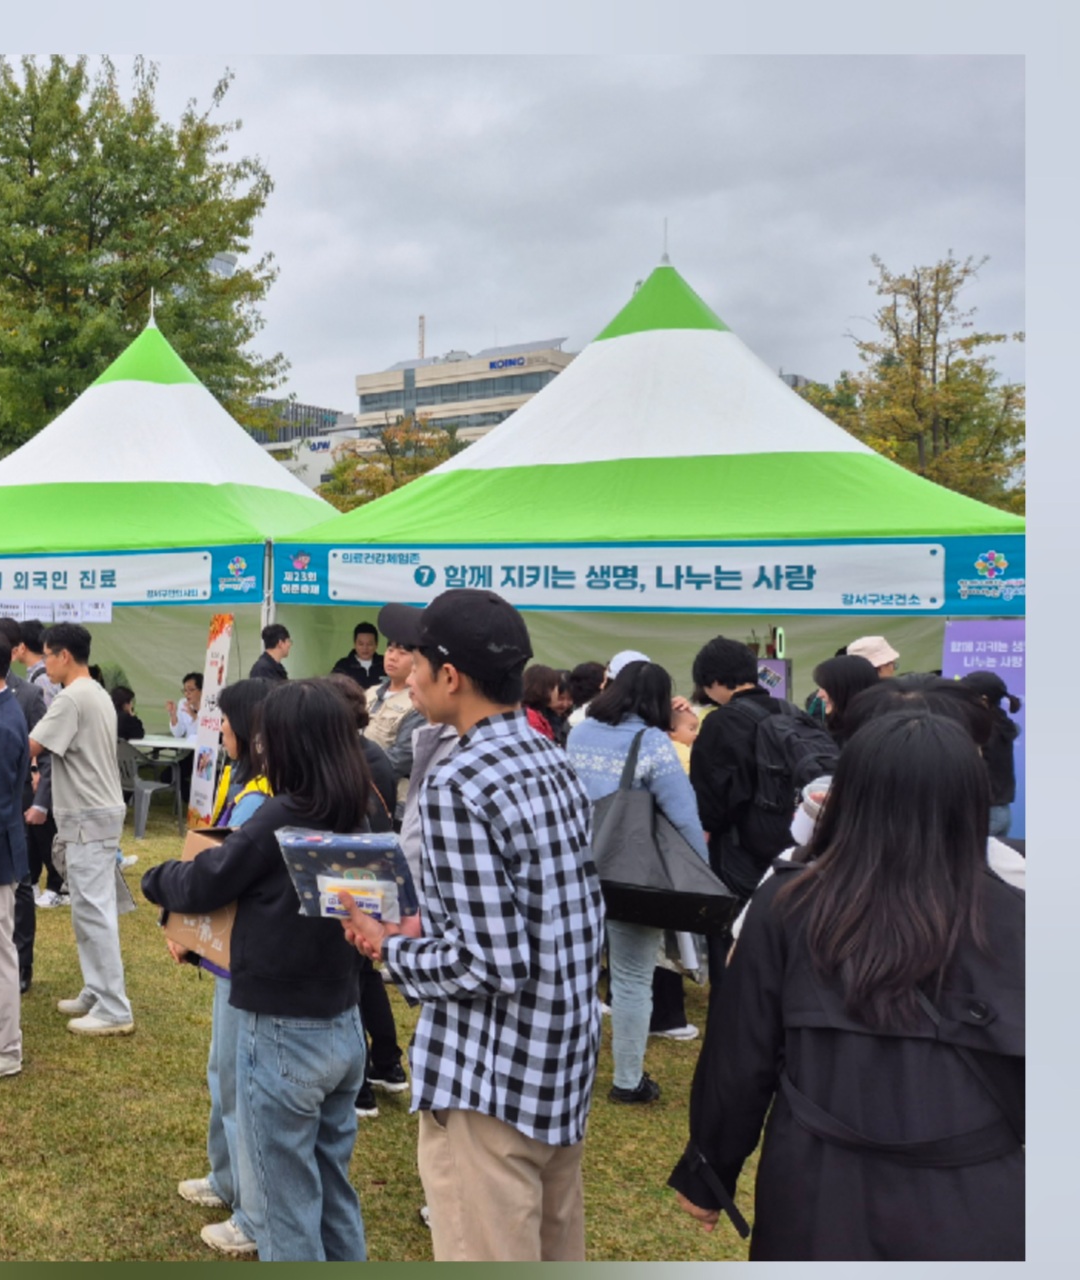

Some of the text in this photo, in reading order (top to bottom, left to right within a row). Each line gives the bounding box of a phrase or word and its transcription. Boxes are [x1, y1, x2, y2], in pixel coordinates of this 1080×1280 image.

[341, 552, 421, 565] 의료건강체험존
[13, 570, 68, 590] 외국인
[79, 569, 118, 589] 진료
[443, 565, 493, 588] 함께
[500, 565, 576, 590] 지키는
[585, 565, 647, 593] 생명,
[655, 565, 743, 591] 나누는
[752, 564, 817, 591] 사랑
[841, 593, 922, 607] 강서구보건소
